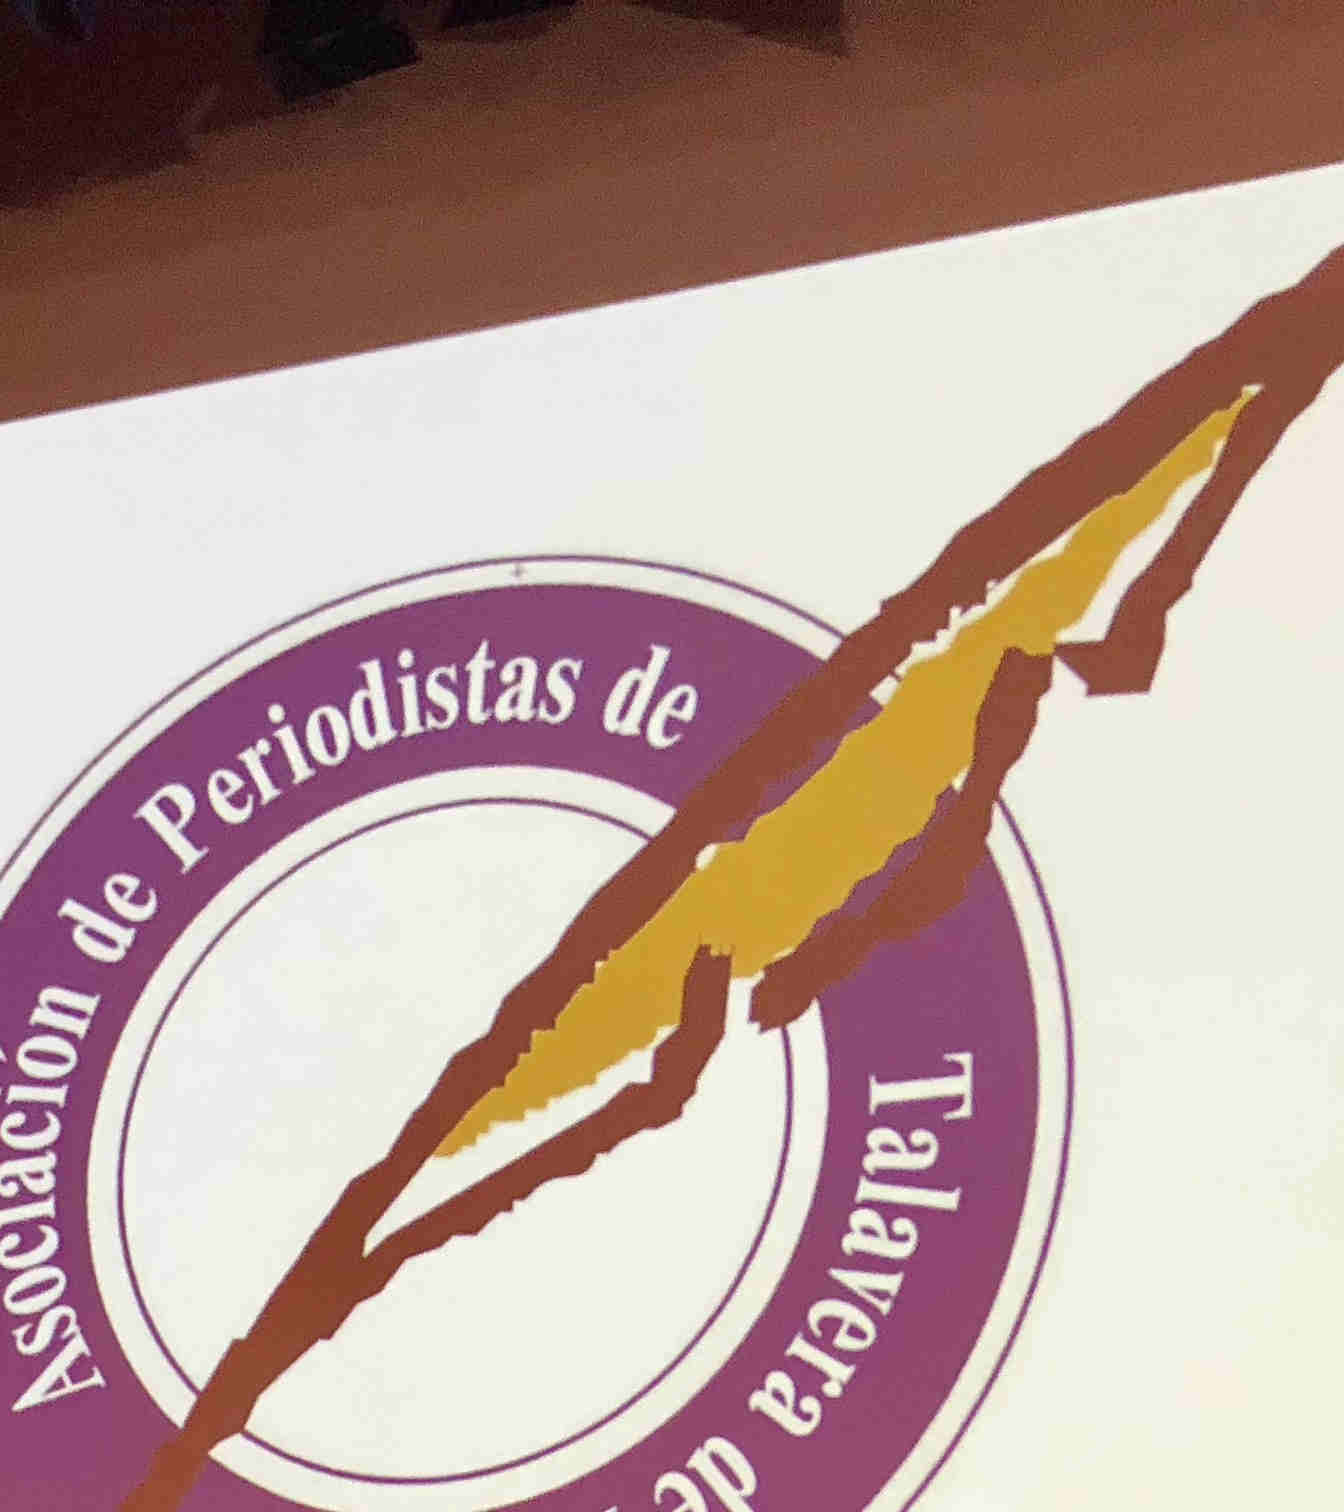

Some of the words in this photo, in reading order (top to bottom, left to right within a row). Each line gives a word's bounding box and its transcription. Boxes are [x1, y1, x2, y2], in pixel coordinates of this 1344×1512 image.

[58, 872, 158, 964] de
[134, 639, 583, 875] Periodistas
[602, 643, 699, 749] de
[748, 1051, 974, 1437] Talavera
